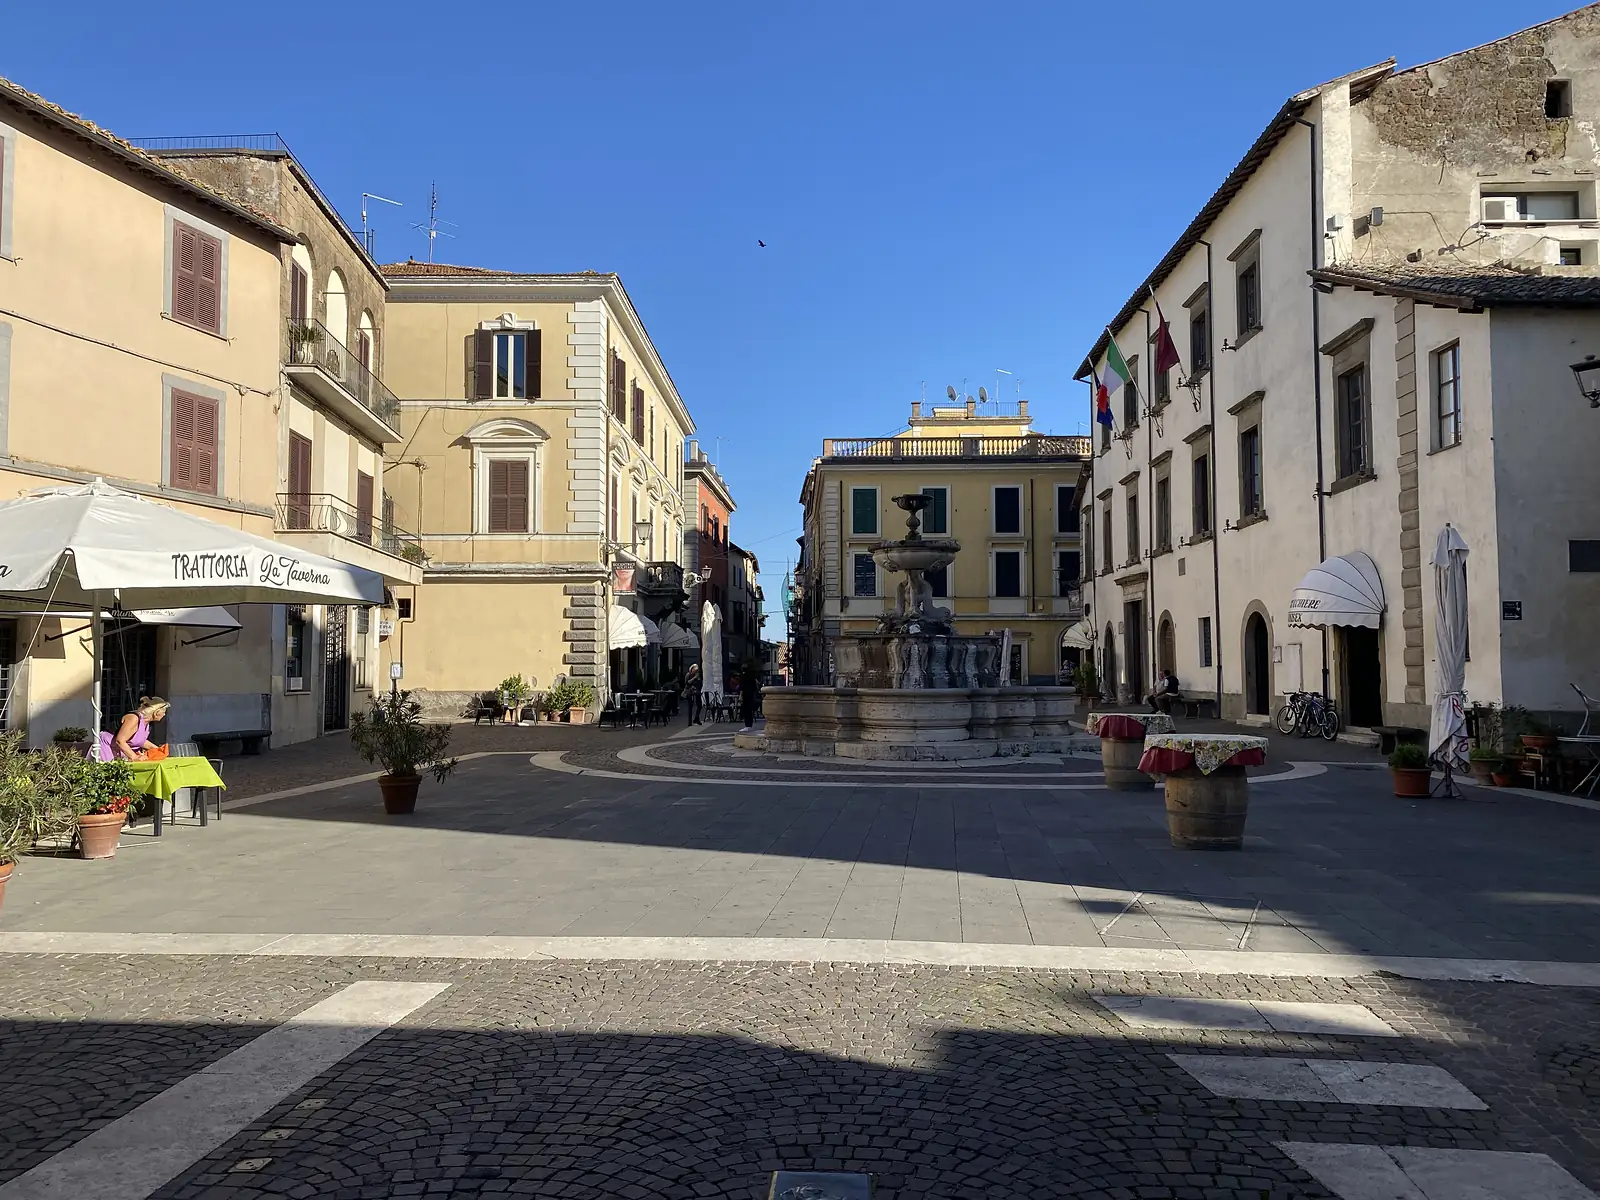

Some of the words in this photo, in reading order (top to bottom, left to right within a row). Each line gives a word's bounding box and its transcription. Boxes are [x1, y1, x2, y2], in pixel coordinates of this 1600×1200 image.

[172, 553, 249, 580] TRATTORIA
[259, 554, 284, 586] La
[279, 556, 331, 586] Taverna
